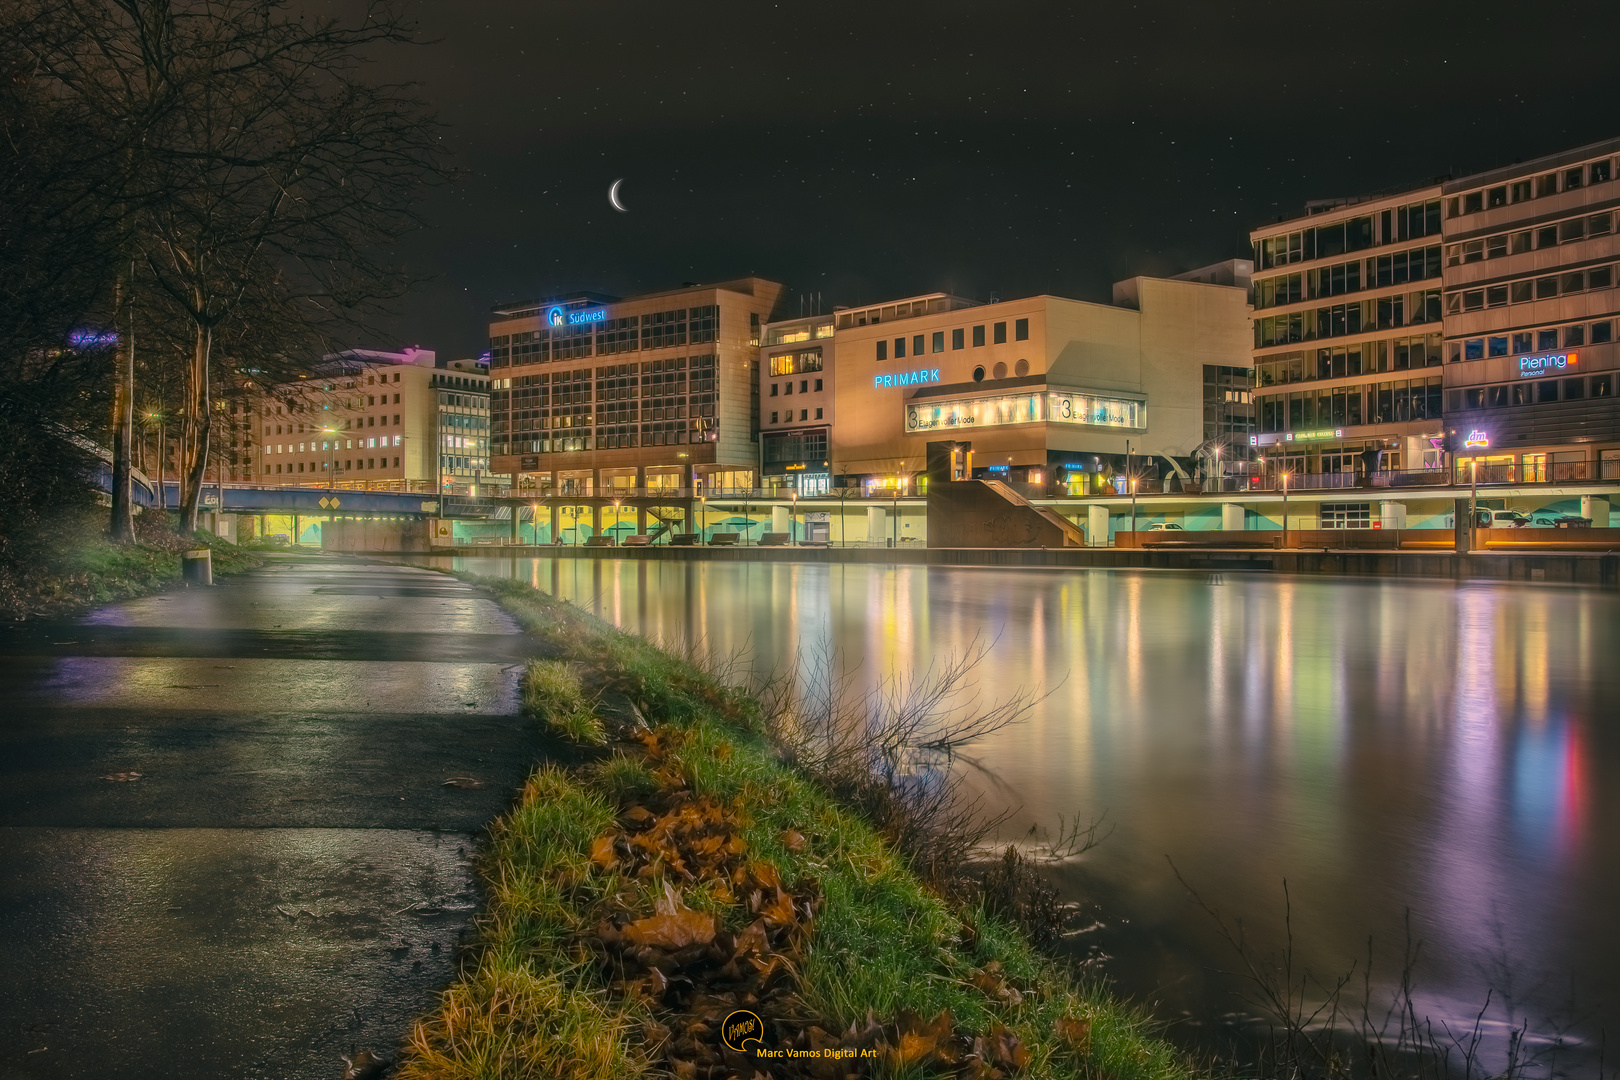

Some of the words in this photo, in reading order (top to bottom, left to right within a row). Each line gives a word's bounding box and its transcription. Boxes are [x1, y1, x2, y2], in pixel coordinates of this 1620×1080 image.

[569, 310, 605, 325] Südwest
[1520, 354, 1567, 370] Piening
[874, 368, 940, 389] PRIMARK
[1520, 369, 1545, 377] Personal
[1061, 399, 1071, 419] 3
[1094, 412, 1108, 422] oller
[1109, 414, 1124, 424] Mode
[908, 411, 918, 429] 3
[919, 419, 940, 429] Etagen
[957, 416, 975, 425] Mode
[1469, 430, 1486, 441] dm
